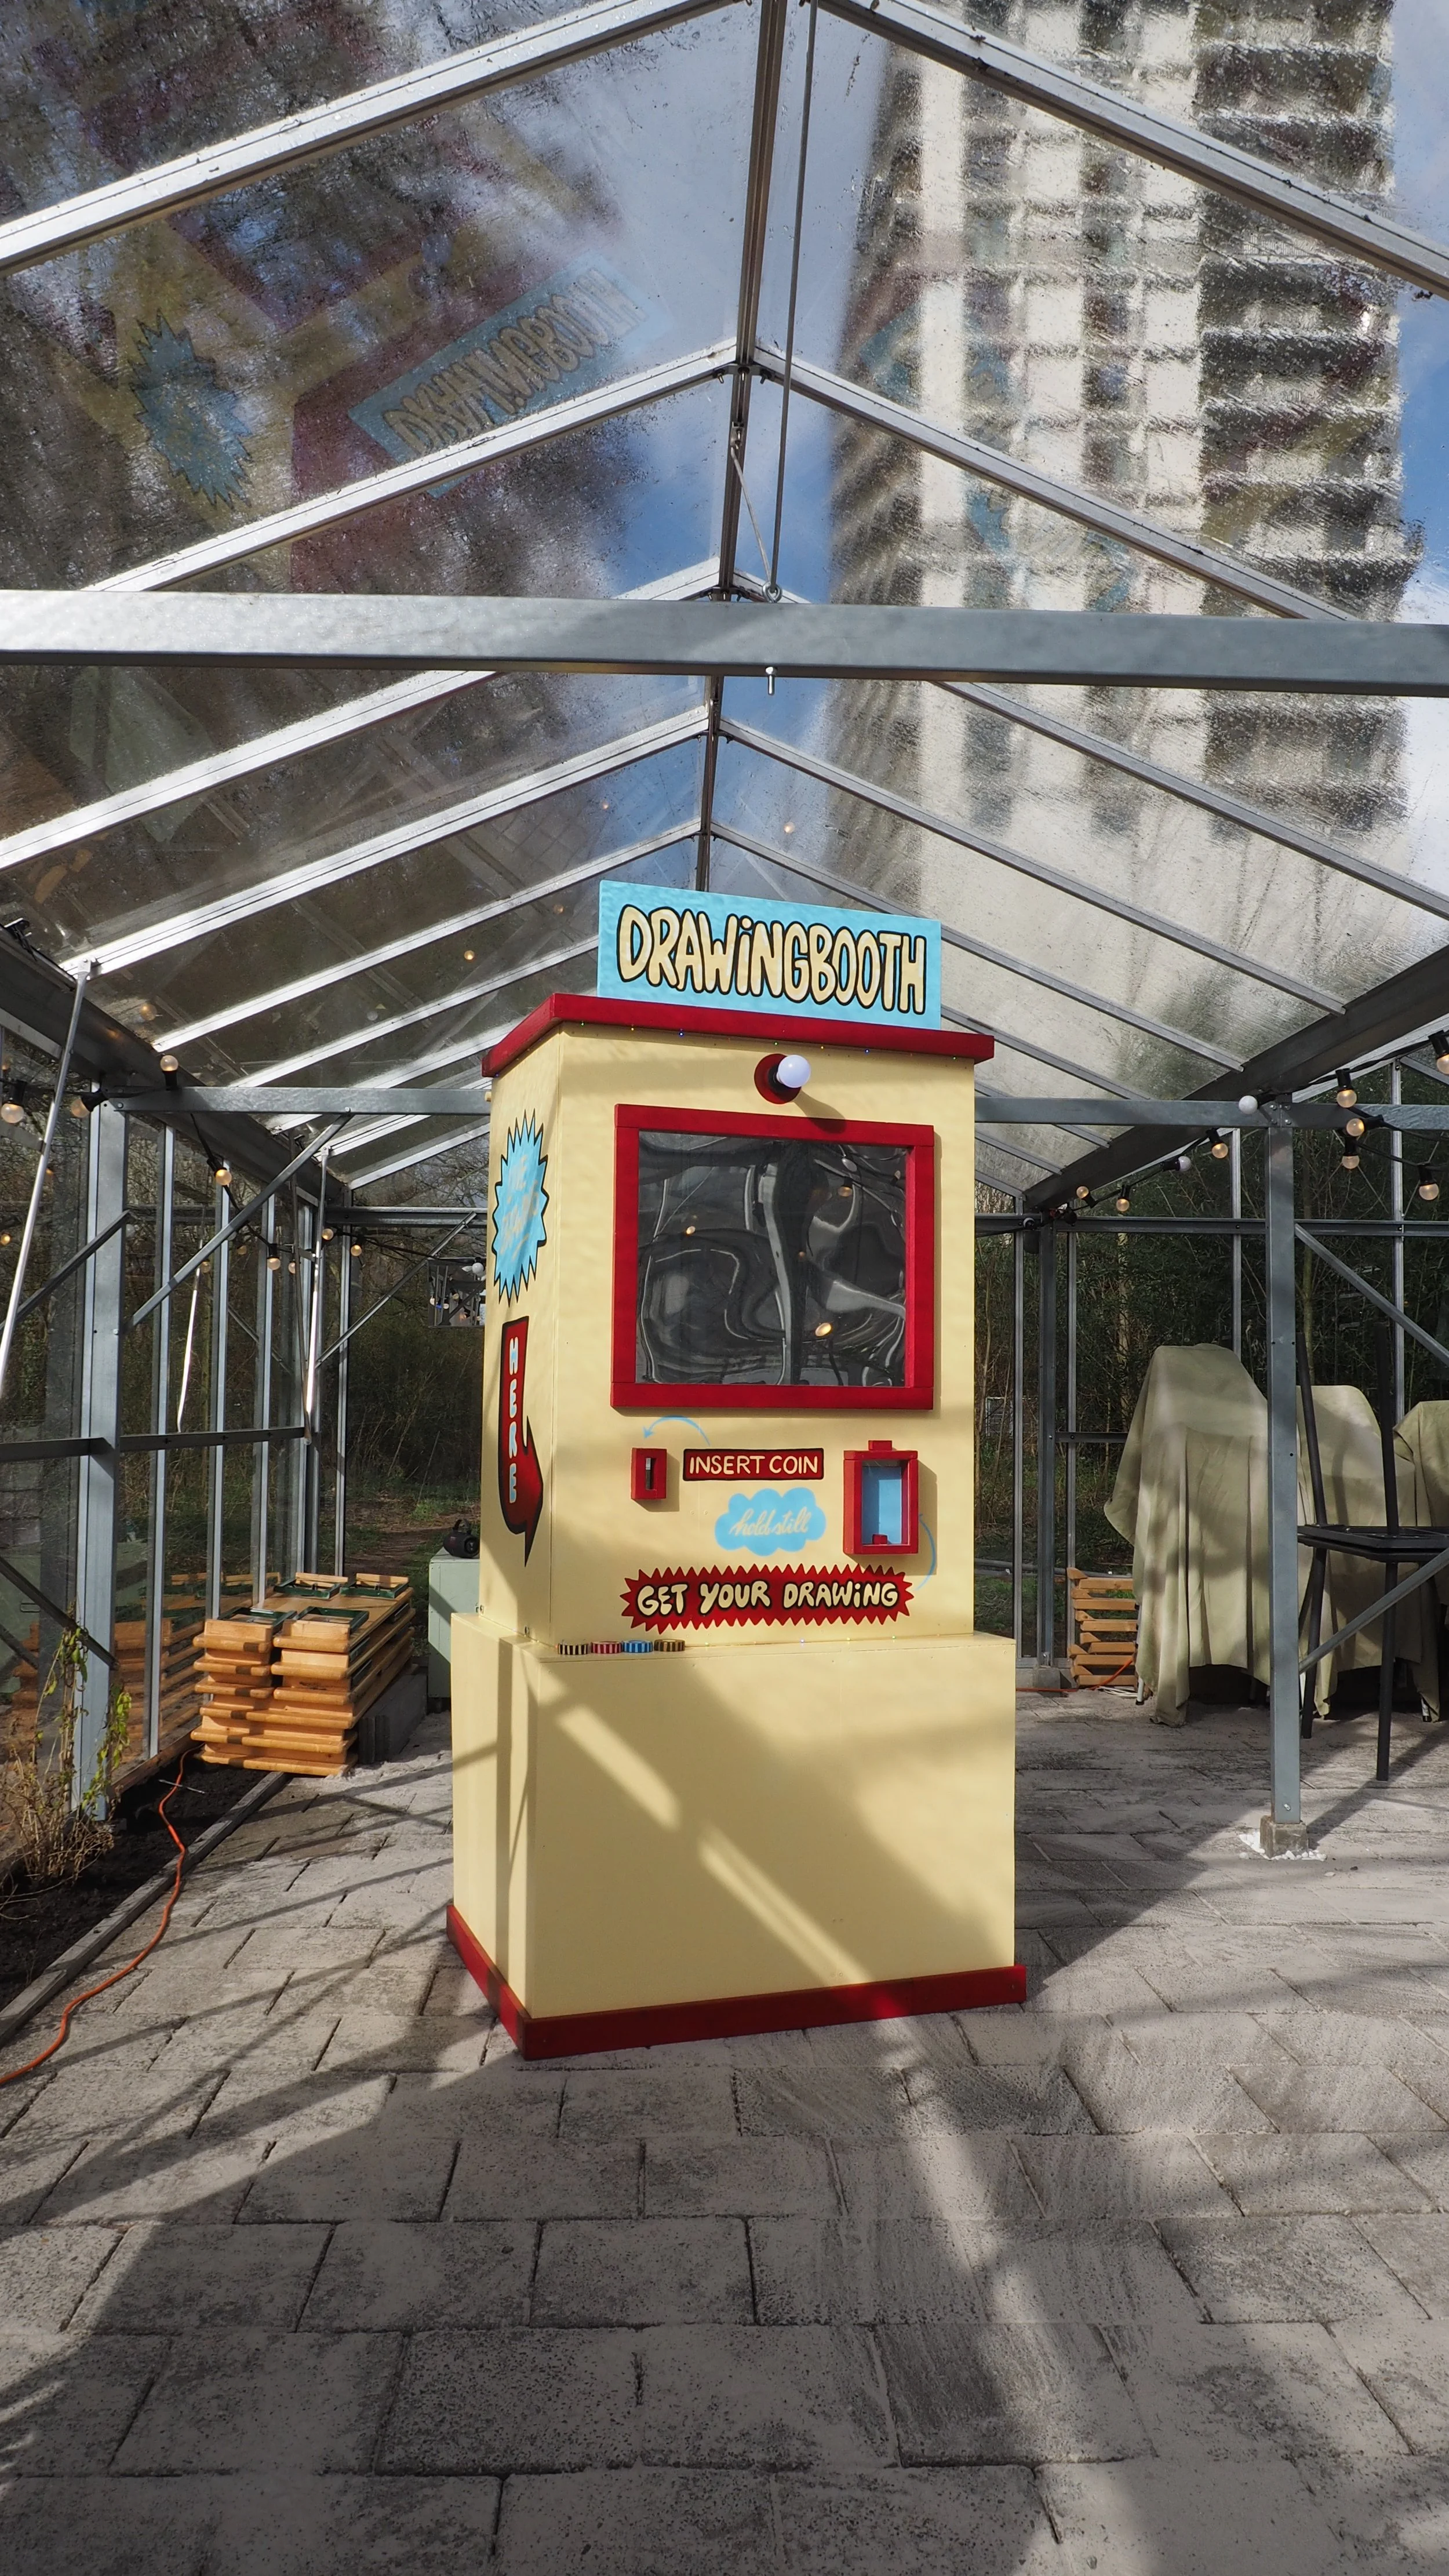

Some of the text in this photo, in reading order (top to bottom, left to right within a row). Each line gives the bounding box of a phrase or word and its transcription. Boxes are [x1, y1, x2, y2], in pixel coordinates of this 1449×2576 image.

[508, 1336, 519, 1504] HERE
[690, 1455, 818, 1475] INSERT COIN
[729, 1506, 811, 1536] hold still
[638, 1584, 688, 1616] GET
[700, 1580, 771, 1615] YOUR
